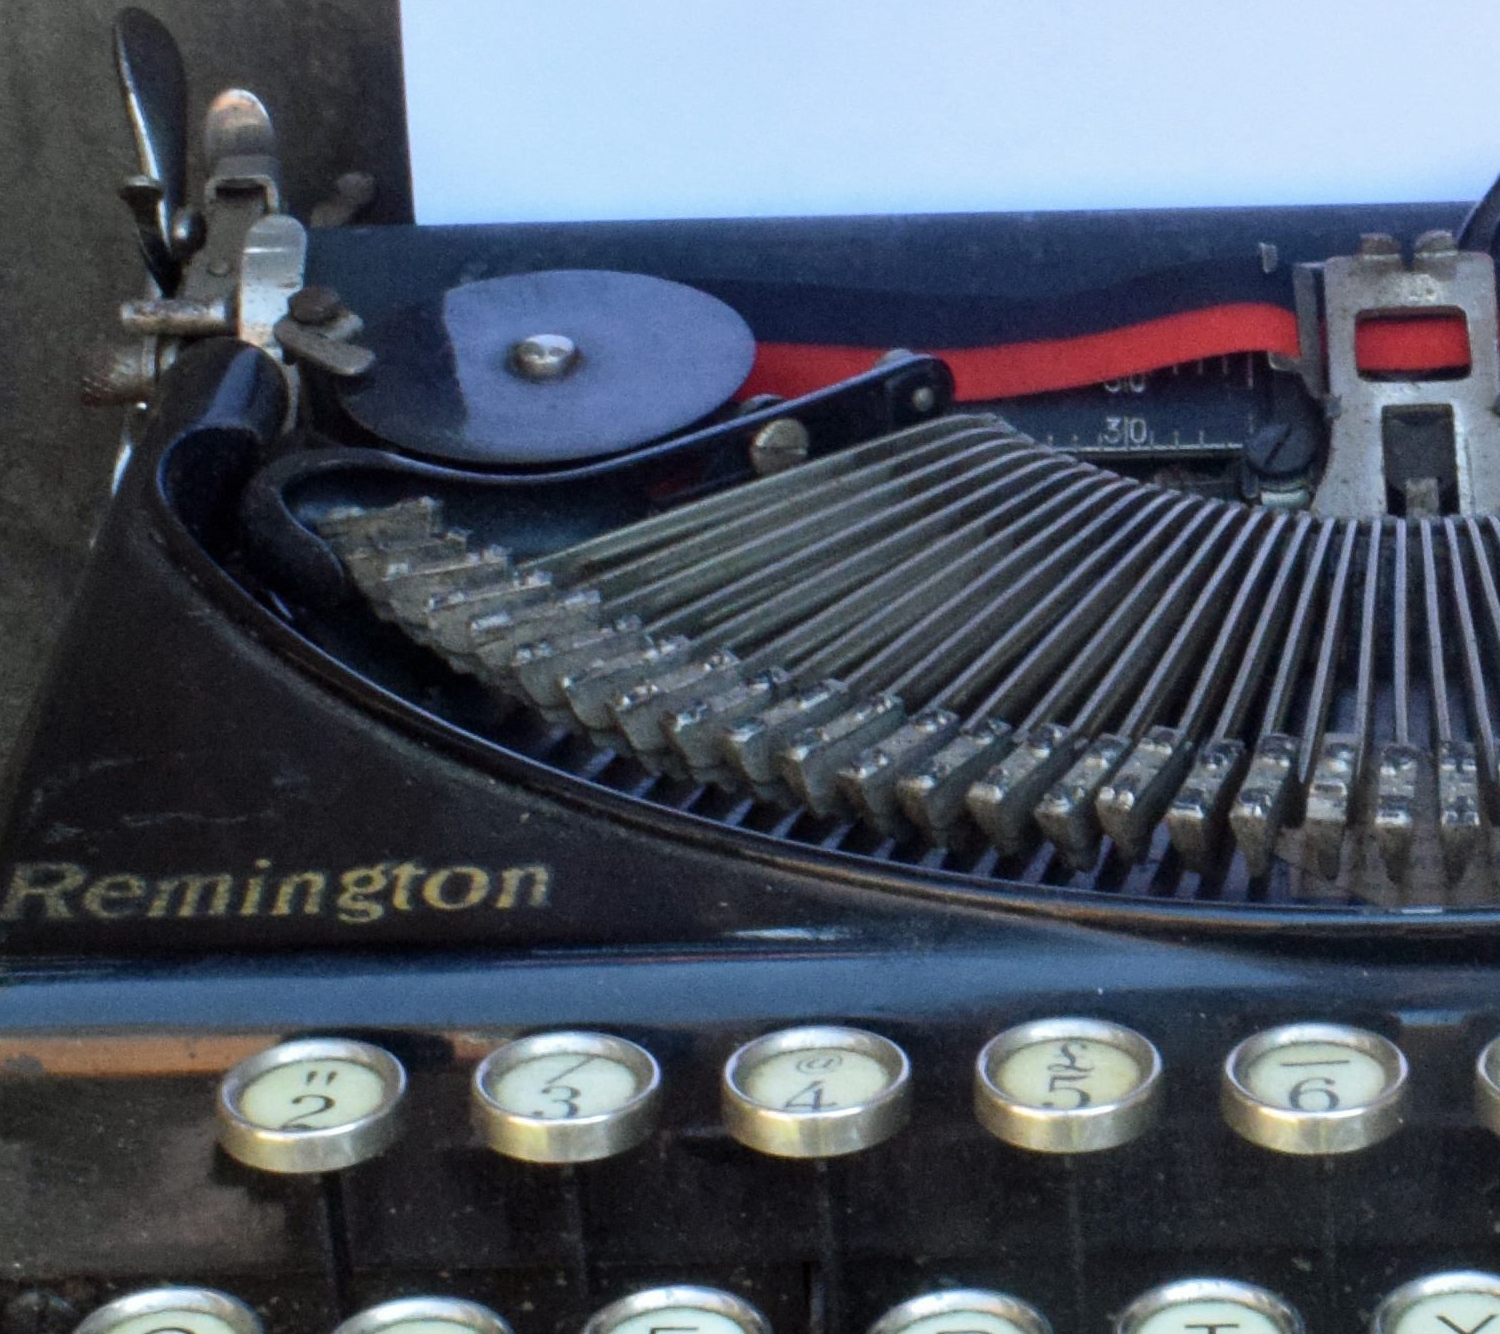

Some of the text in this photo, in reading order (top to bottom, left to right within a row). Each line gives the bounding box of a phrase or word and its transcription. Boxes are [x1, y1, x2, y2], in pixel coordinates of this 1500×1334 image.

[0, 859, 552, 924] Remington
[532, 1086, 582, 1119] 3
[785, 1080, 838, 1110] 4
[1289, 1077, 1339, 1110] 6
[282, 1094, 336, 1131] 2
